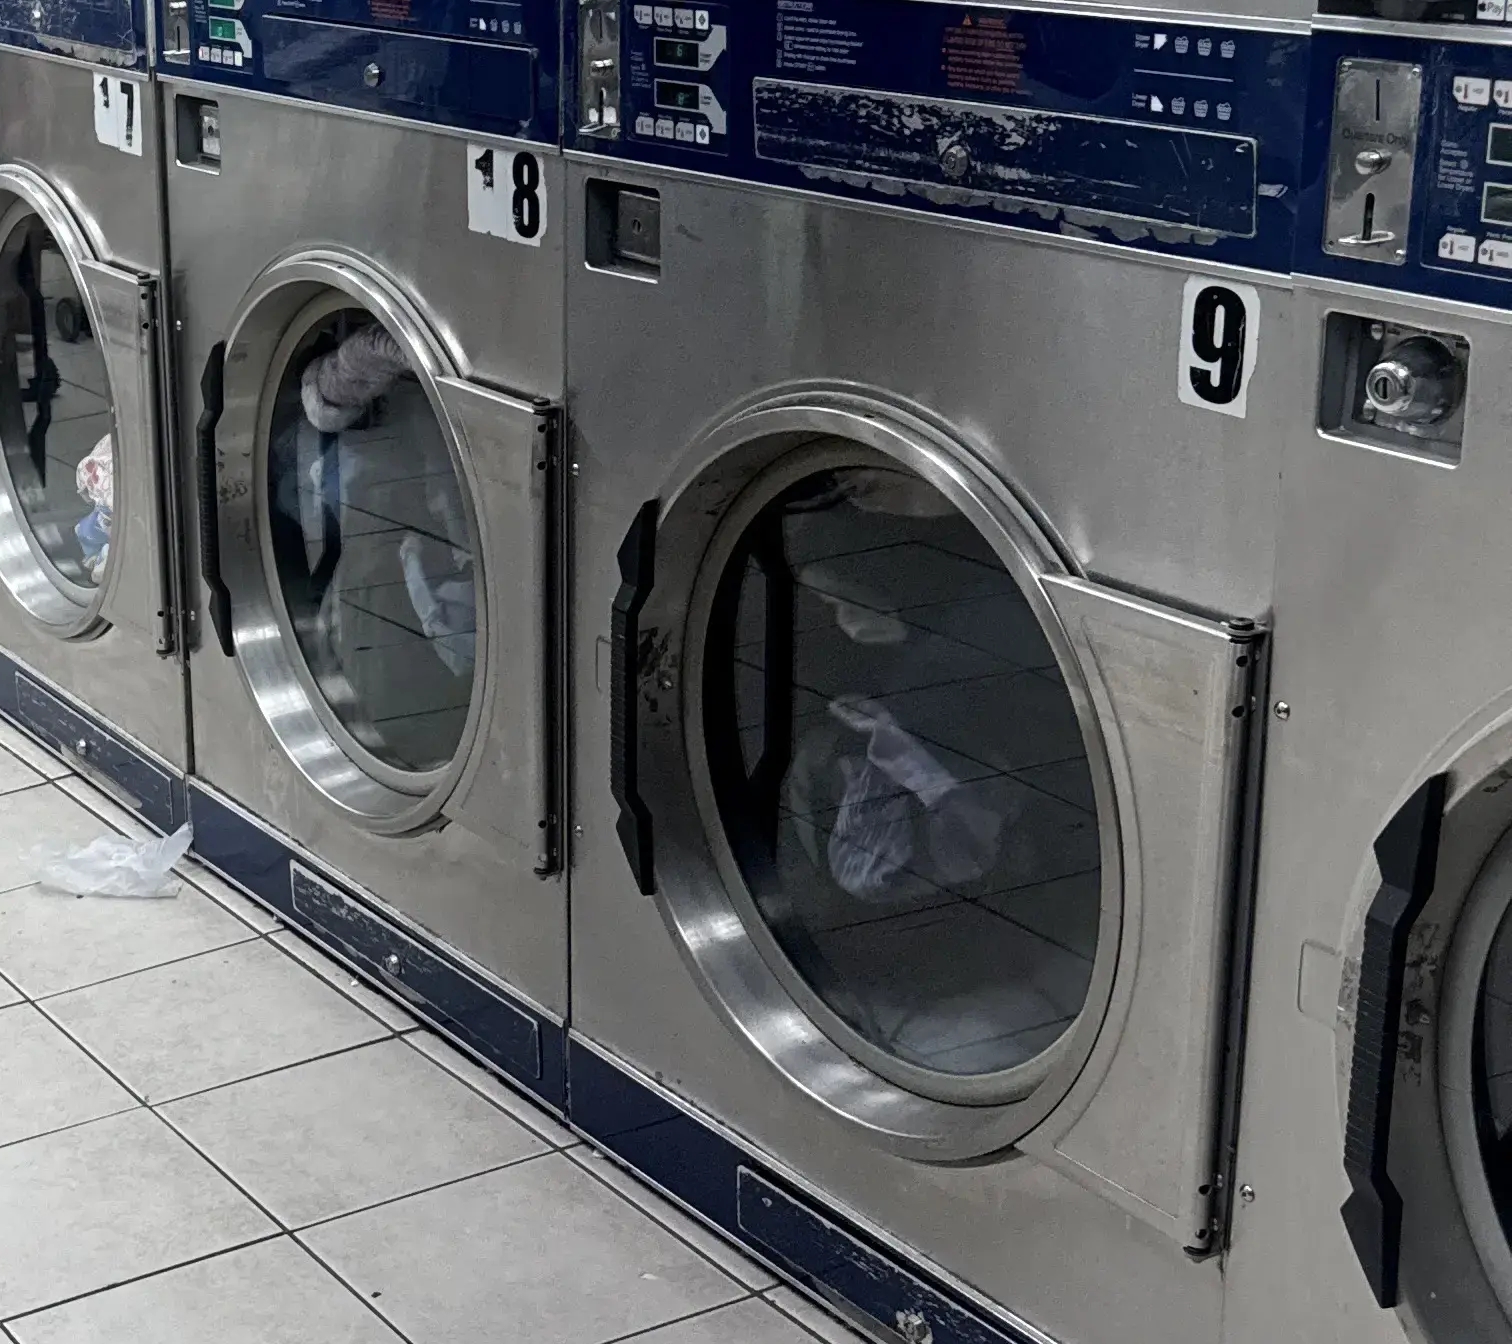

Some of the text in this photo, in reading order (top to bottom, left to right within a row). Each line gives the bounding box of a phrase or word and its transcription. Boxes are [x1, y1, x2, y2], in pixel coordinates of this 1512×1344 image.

[1342, 128, 1410, 148] Quarters Only
[1189, 285, 1245, 406] 9
